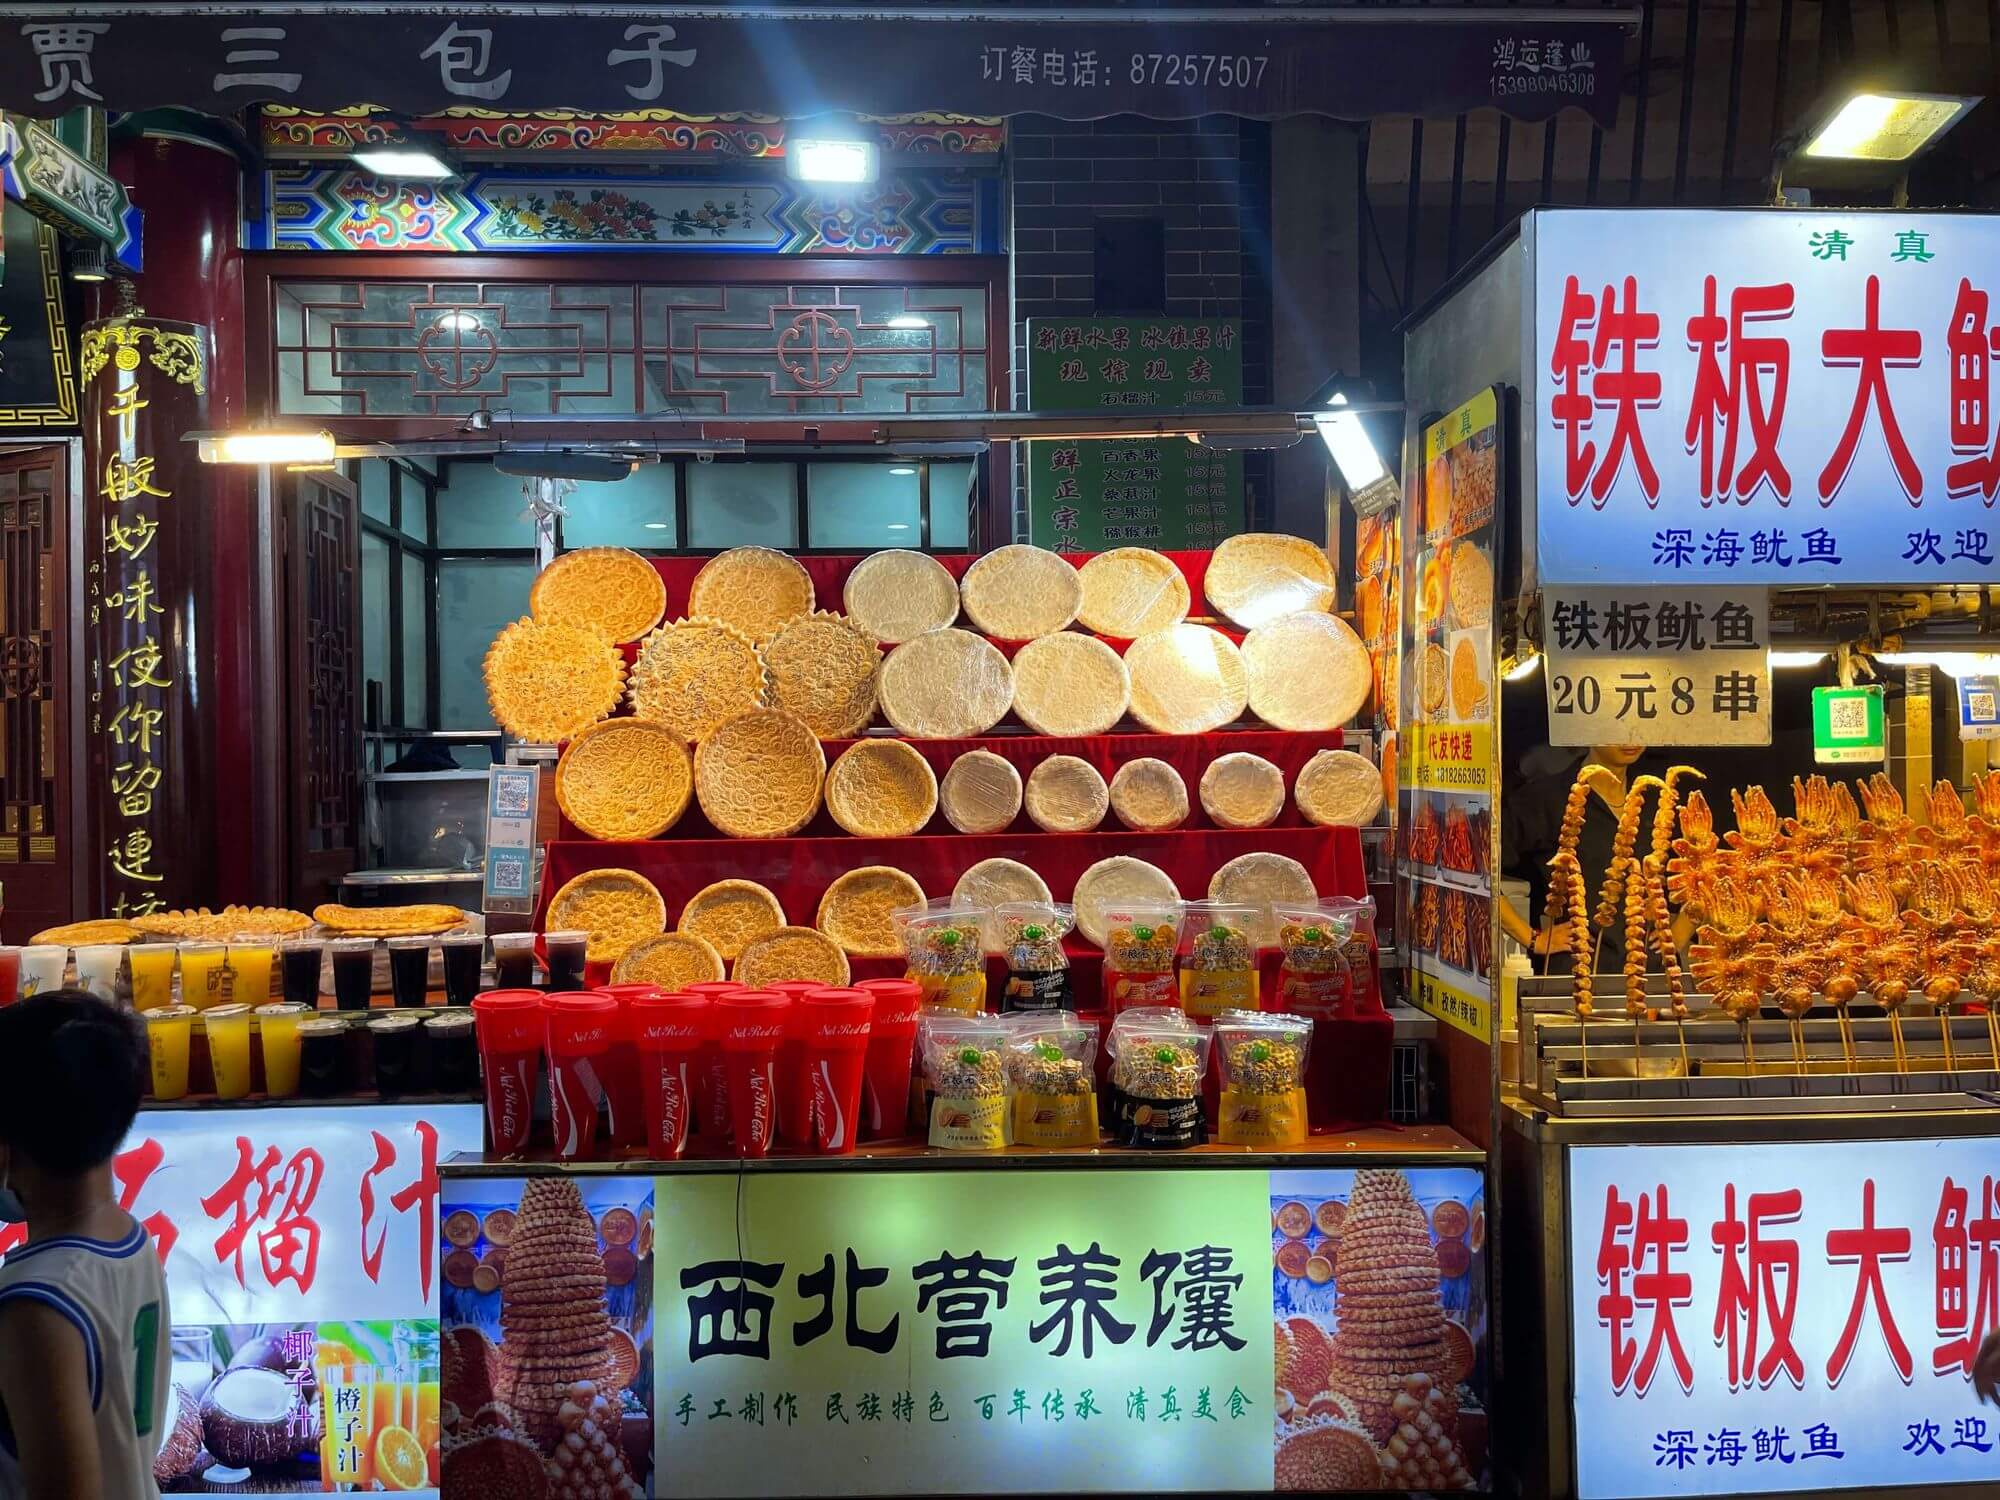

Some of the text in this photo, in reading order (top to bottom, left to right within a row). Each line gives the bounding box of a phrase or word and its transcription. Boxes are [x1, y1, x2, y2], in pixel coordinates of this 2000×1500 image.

[20, 21, 698, 102] 贾三包子
[1489, 72, 1595, 97] 15398046308
[1808, 229, 1936, 263] 清真
[1036, 325, 1236, 352] 新鲜水果 冰镇果汁
[1060, 356, 1213, 384] 现榨现卖
[1102, 391, 1158, 405] 石榴汁
[1435, 408, 1472, 450] 清真
[1102, 449, 1160, 463] 百香果
[1102, 467, 1160, 482] 火龙果
[1051, 440, 1086, 553] 鲜正宗水
[1103, 505, 1159, 520] 芒果汁
[1651, 527, 1994, 568] 深海鱿鱼 欢迎
[1552, 599, 1761, 652] 铁板鱿鱼
[1428, 730, 1472, 761] 代发快递
[680, 1241, 1248, 1363] 西北营养馕
[282, 1329, 314, 1439] 椰子汁
[675, 1384, 1255, 1427] 手工制作 民族特色 百年传承 清真美食
[334, 1386, 365, 1474] 橙子汁
[1653, 1416, 1993, 1470] 深海鱿鱼 欢迎
